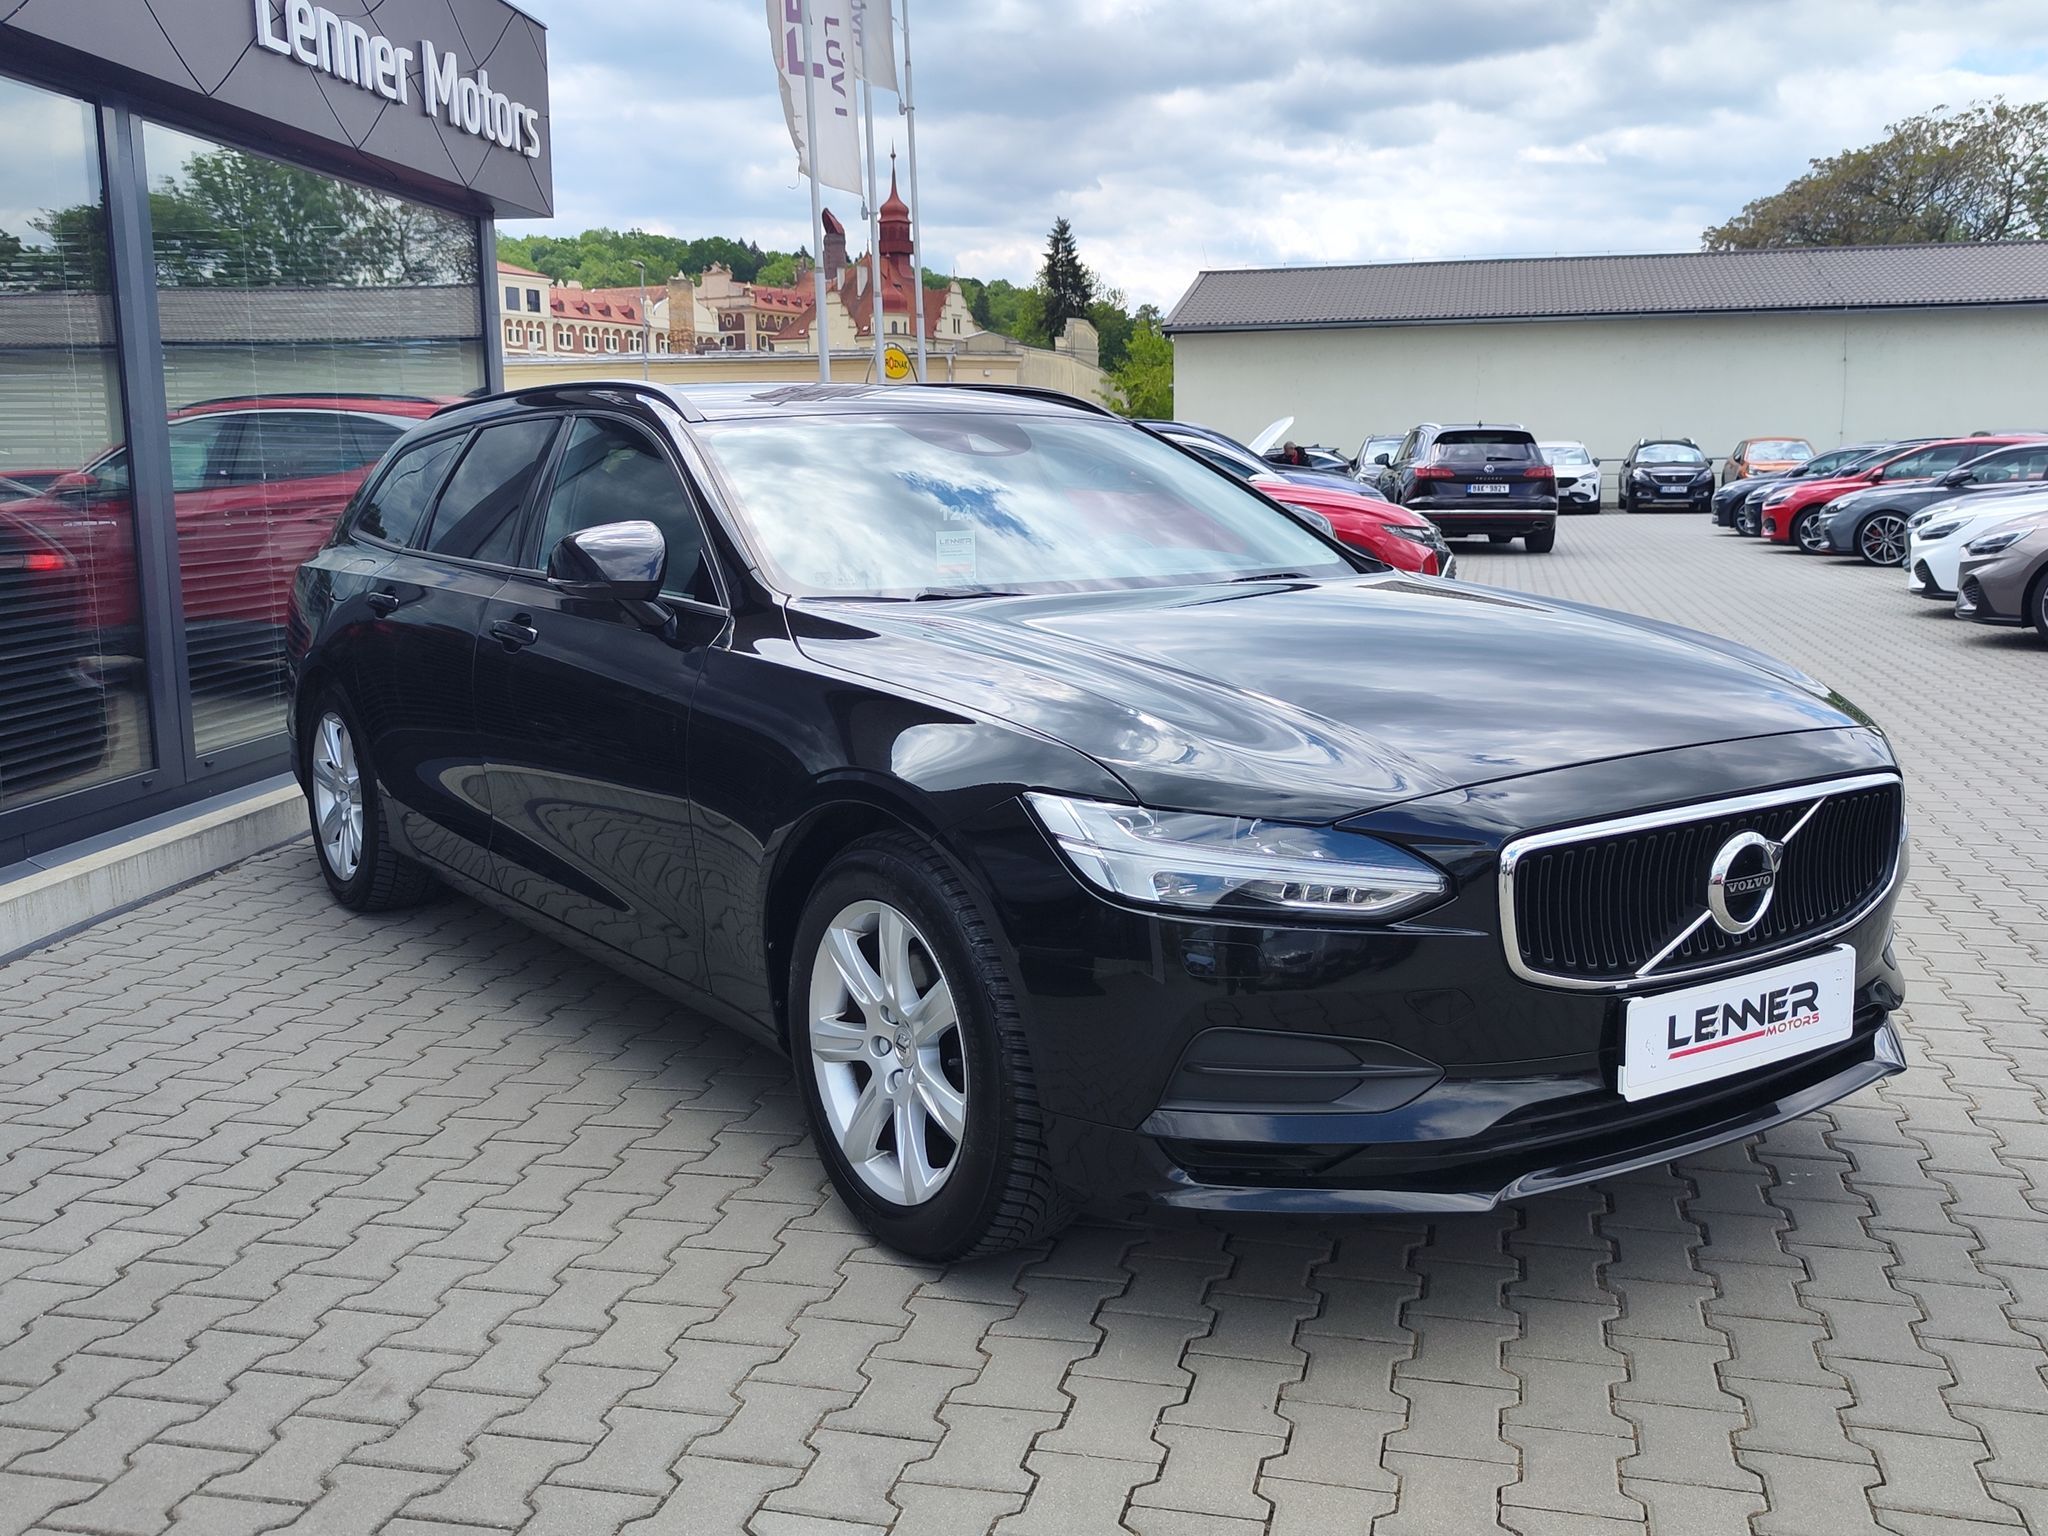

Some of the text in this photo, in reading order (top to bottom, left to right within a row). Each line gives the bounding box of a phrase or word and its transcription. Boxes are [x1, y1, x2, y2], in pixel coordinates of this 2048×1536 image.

[255, 0, 541, 158] Lenner Motors
[1726, 874, 1771, 894] VOLVO
[1667, 980, 1820, 1050] LENNER
[1765, 1011, 1820, 1038] MOTORS
